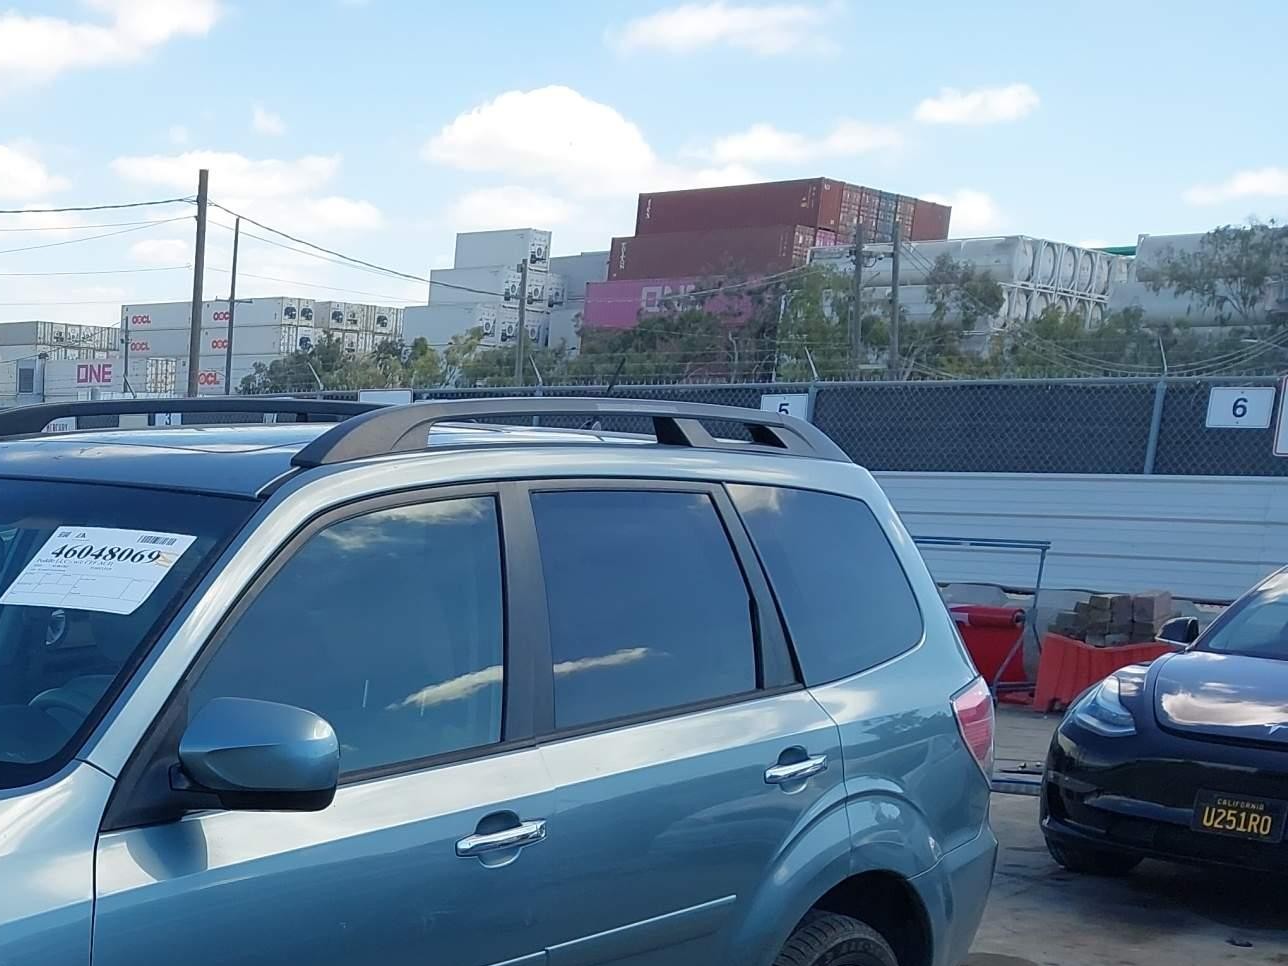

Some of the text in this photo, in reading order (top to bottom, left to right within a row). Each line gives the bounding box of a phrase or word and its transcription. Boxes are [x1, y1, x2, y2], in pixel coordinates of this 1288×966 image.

[132, 315, 151, 325] OOCL
[213, 311, 230, 321] OOC
[130, 342, 150, 351] OOCL
[212, 340, 229, 348] OOC
[77, 364, 112, 383] ONE
[197, 372, 220, 385] OCL
[1232, 397, 1248, 418] 6
[51, 543, 161, 564] 46048069
[1217, 798, 1265, 810] CALIFORNIA
